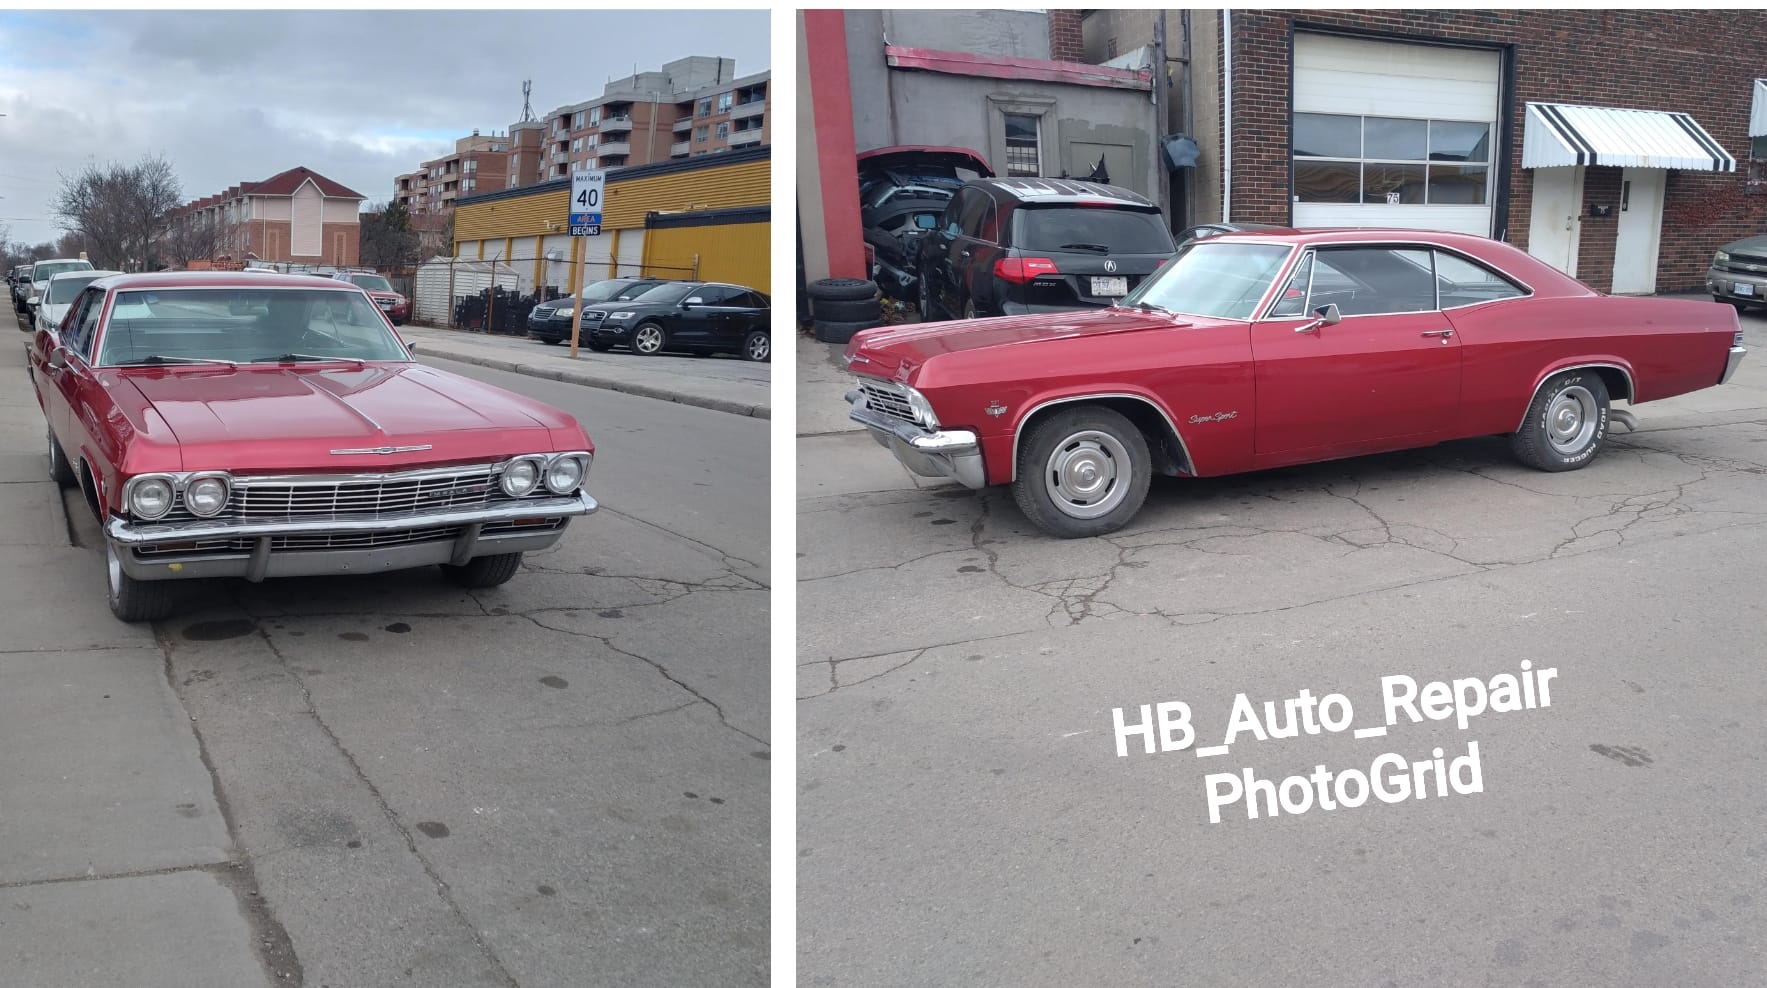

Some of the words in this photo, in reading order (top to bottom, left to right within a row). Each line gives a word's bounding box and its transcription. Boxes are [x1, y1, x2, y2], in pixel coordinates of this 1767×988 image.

[576, 188, 598, 207] 40
[576, 215, 596, 223] AREA
[572, 226, 599, 235] BEGINS
[1596, 407, 1607, 440] ROAD
[1563, 442, 1597, 463] HUGGER
